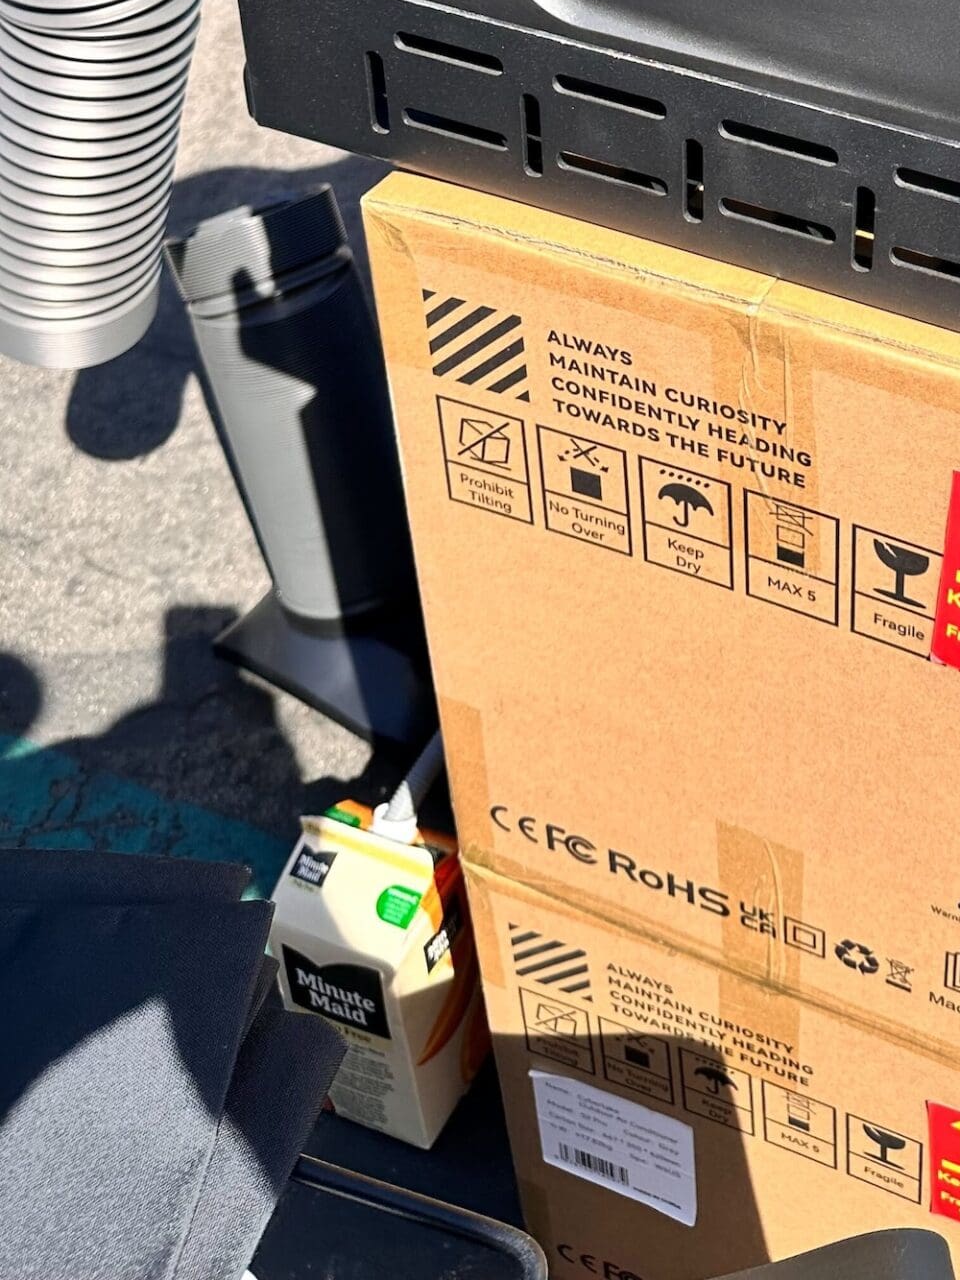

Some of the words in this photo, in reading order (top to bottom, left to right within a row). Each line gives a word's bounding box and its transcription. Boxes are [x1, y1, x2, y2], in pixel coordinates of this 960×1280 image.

[547, 330, 632, 366] ALWAYS
[549, 352, 656, 397] MAINTAIN
[665, 388, 787, 436] CURIOSITY
[551, 377, 700, 432] CONFIDENTLY
[708, 423, 812, 467] HEADING
[552, 398, 660, 442] TOWARDS
[666, 432, 709, 458] THE
[717, 448, 806, 489] FUTURE
[460, 473, 514, 499] Prohibit
[469, 490, 512, 514] Tilting
[549, 500, 569, 516] No
[572, 507, 625, 536] Turning
[571, 522, 605, 541] Over
[667, 538, 705, 560] Keep
[676, 556, 702, 574] Dry
[767, 576, 803, 597] MAX
[807, 590, 817, 602] 5
[873, 613, 925, 641] Fragile
[490, 805, 539, 843] CE
[608, 848, 731, 918] RoHS
[295, 968, 376, 1013] Minute
[607, 962, 674, 994] ALWAYS
[309, 989, 368, 1026] Maid
[608, 975, 693, 1016] MAINTAIN
[699, 1011, 793, 1054] CURIOSITY
[609, 990, 726, 1040] CONFIDENTLY
[732, 1036, 814, 1075] HEADING
[611, 1001, 695, 1041] TOWARDS
[740, 1052, 809, 1087] FUTURE
[781, 1131, 808, 1150] MAX
[864, 1165, 904, 1189] Fragile
